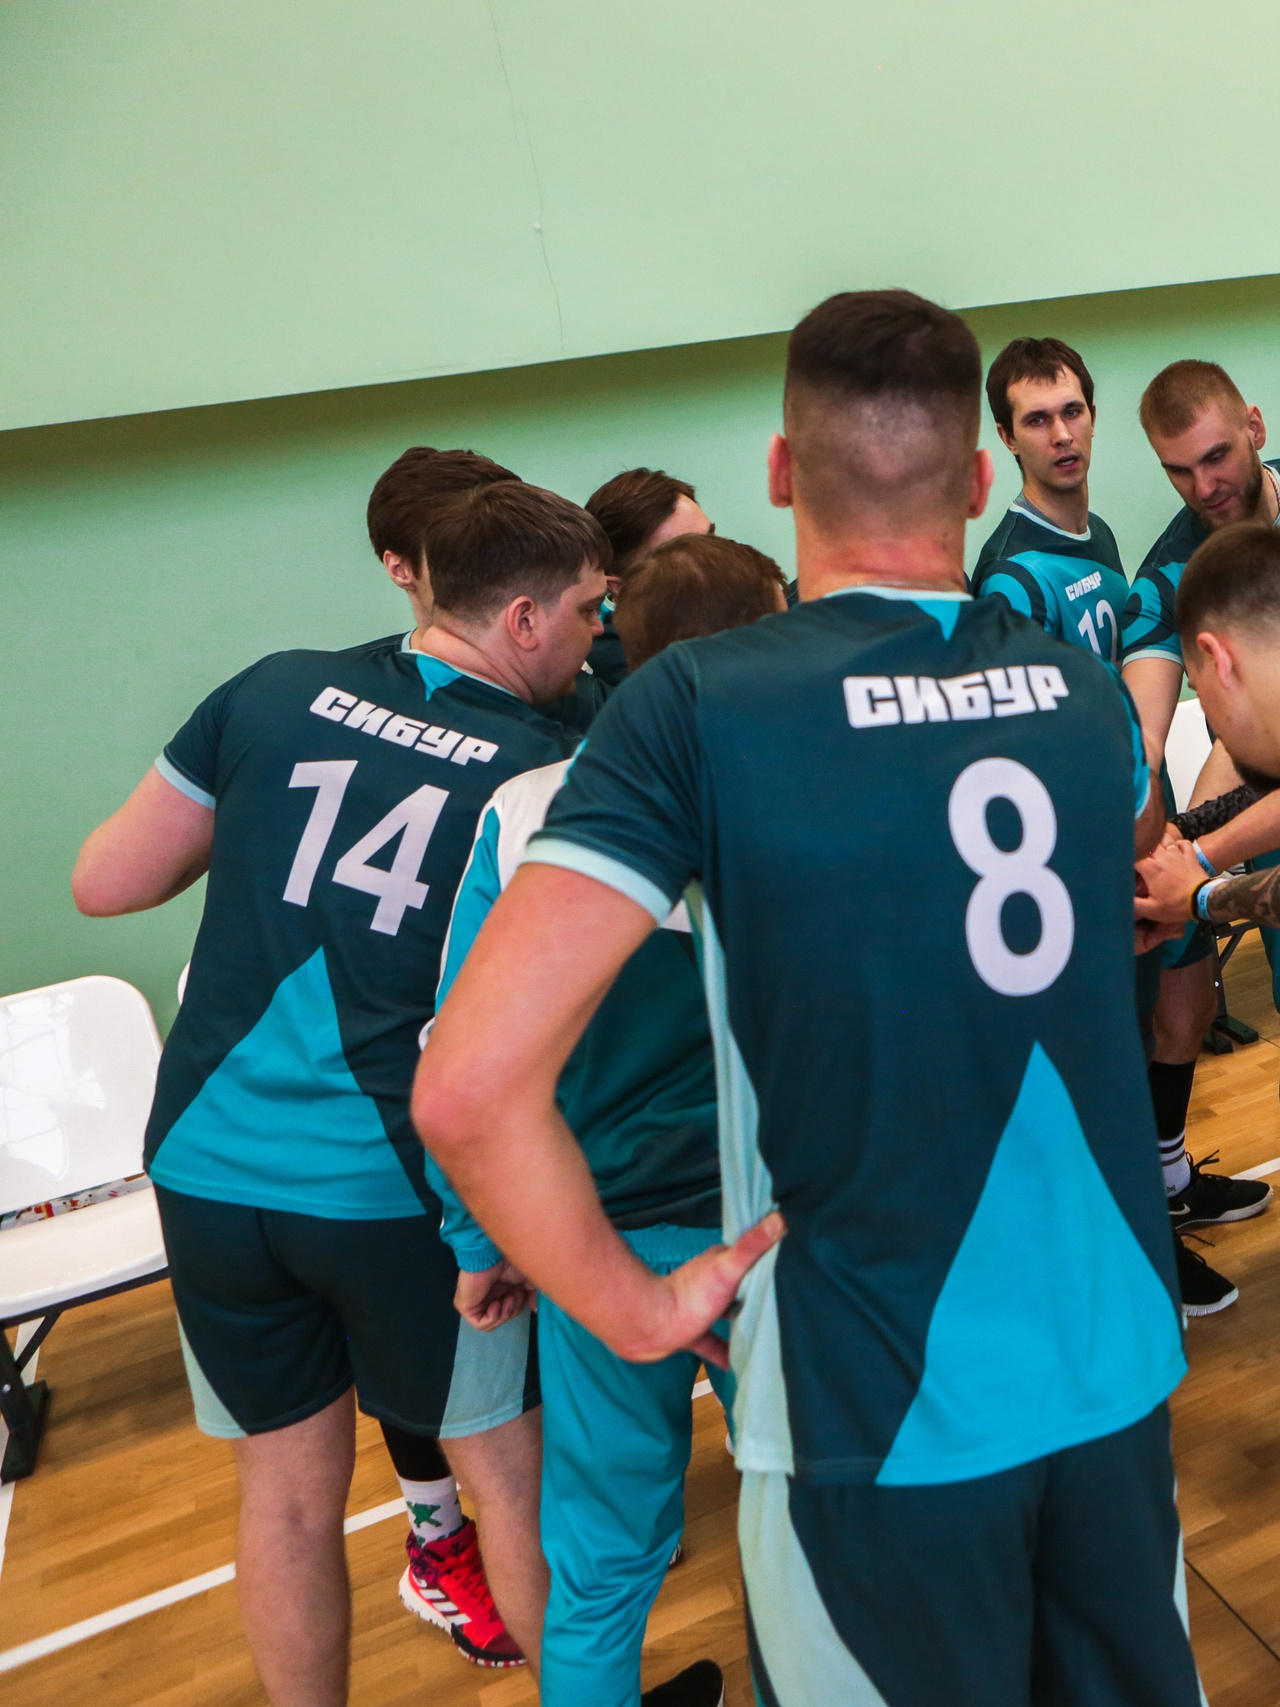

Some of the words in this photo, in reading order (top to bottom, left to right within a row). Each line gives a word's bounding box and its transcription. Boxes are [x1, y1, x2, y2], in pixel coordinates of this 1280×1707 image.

[1064, 571, 1102, 602] СИБУР
[309, 686, 500, 766] СИБУР
[843, 665, 1069, 729] СИБУР
[282, 759, 450, 936] 14
[948, 757, 1075, 997] 8
